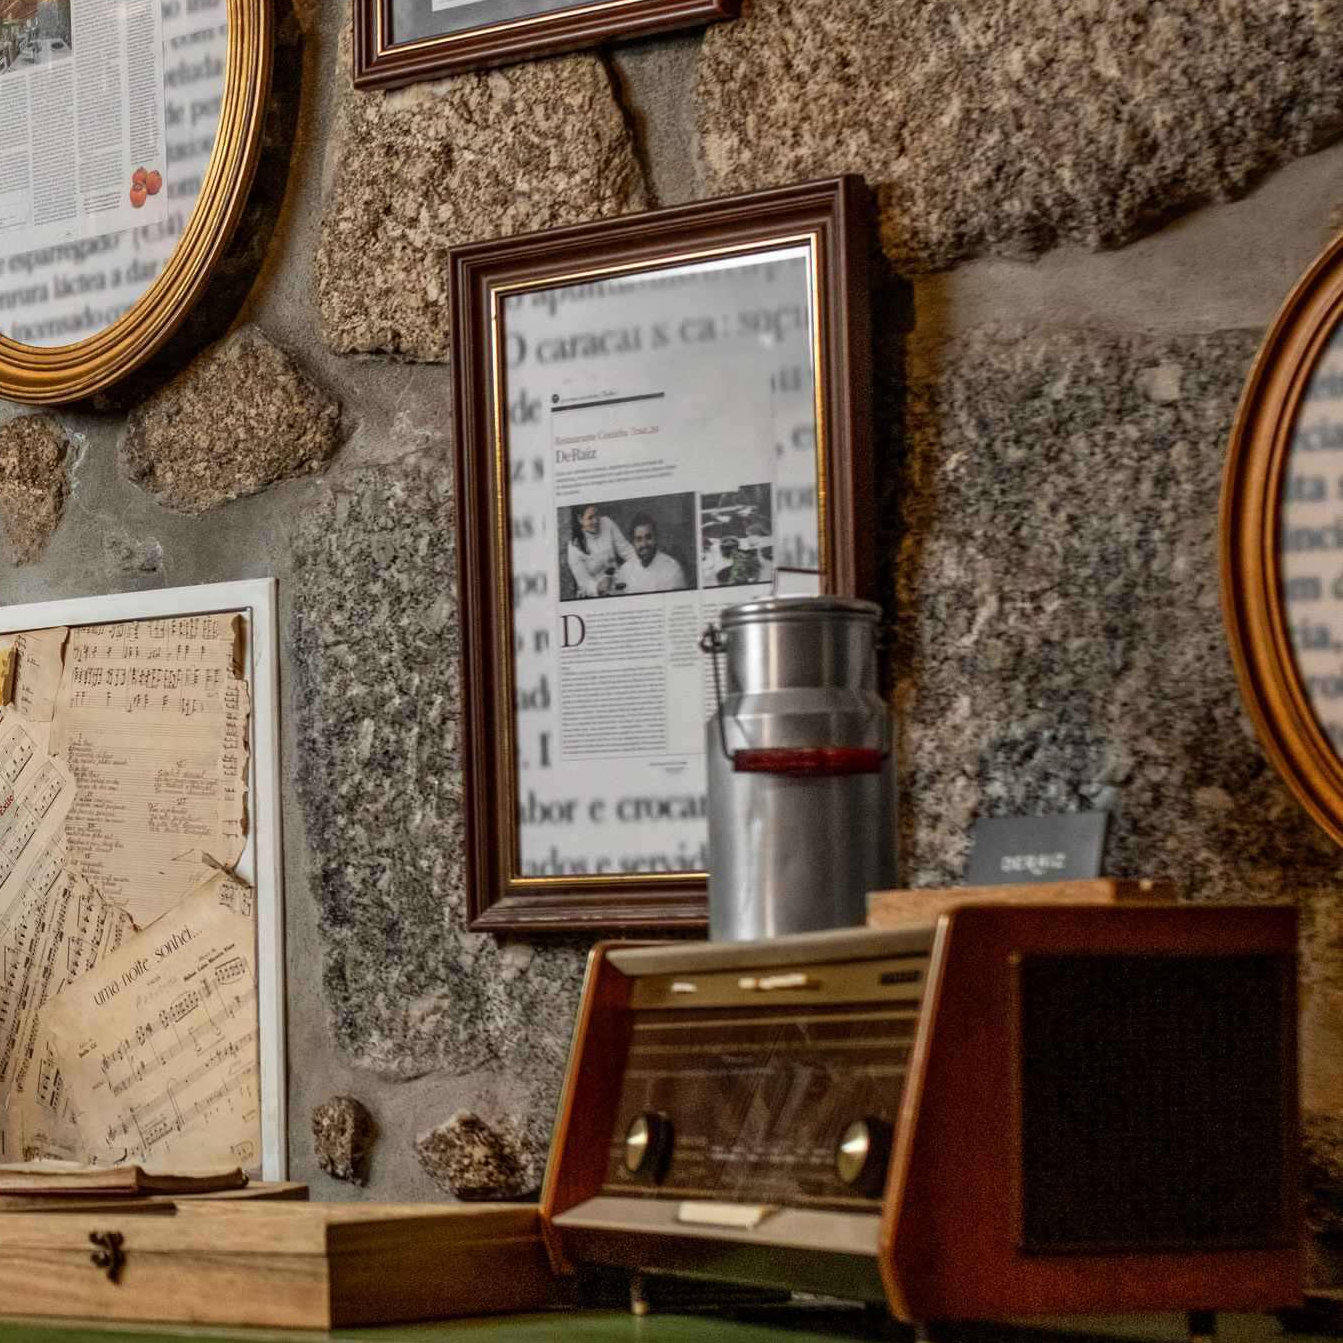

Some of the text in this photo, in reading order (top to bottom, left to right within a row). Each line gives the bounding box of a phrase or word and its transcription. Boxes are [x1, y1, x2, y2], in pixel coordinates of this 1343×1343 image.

[560, 614, 587, 649] D
[93, 980, 121, 1007] uma
[121, 957, 149, 988] noite
